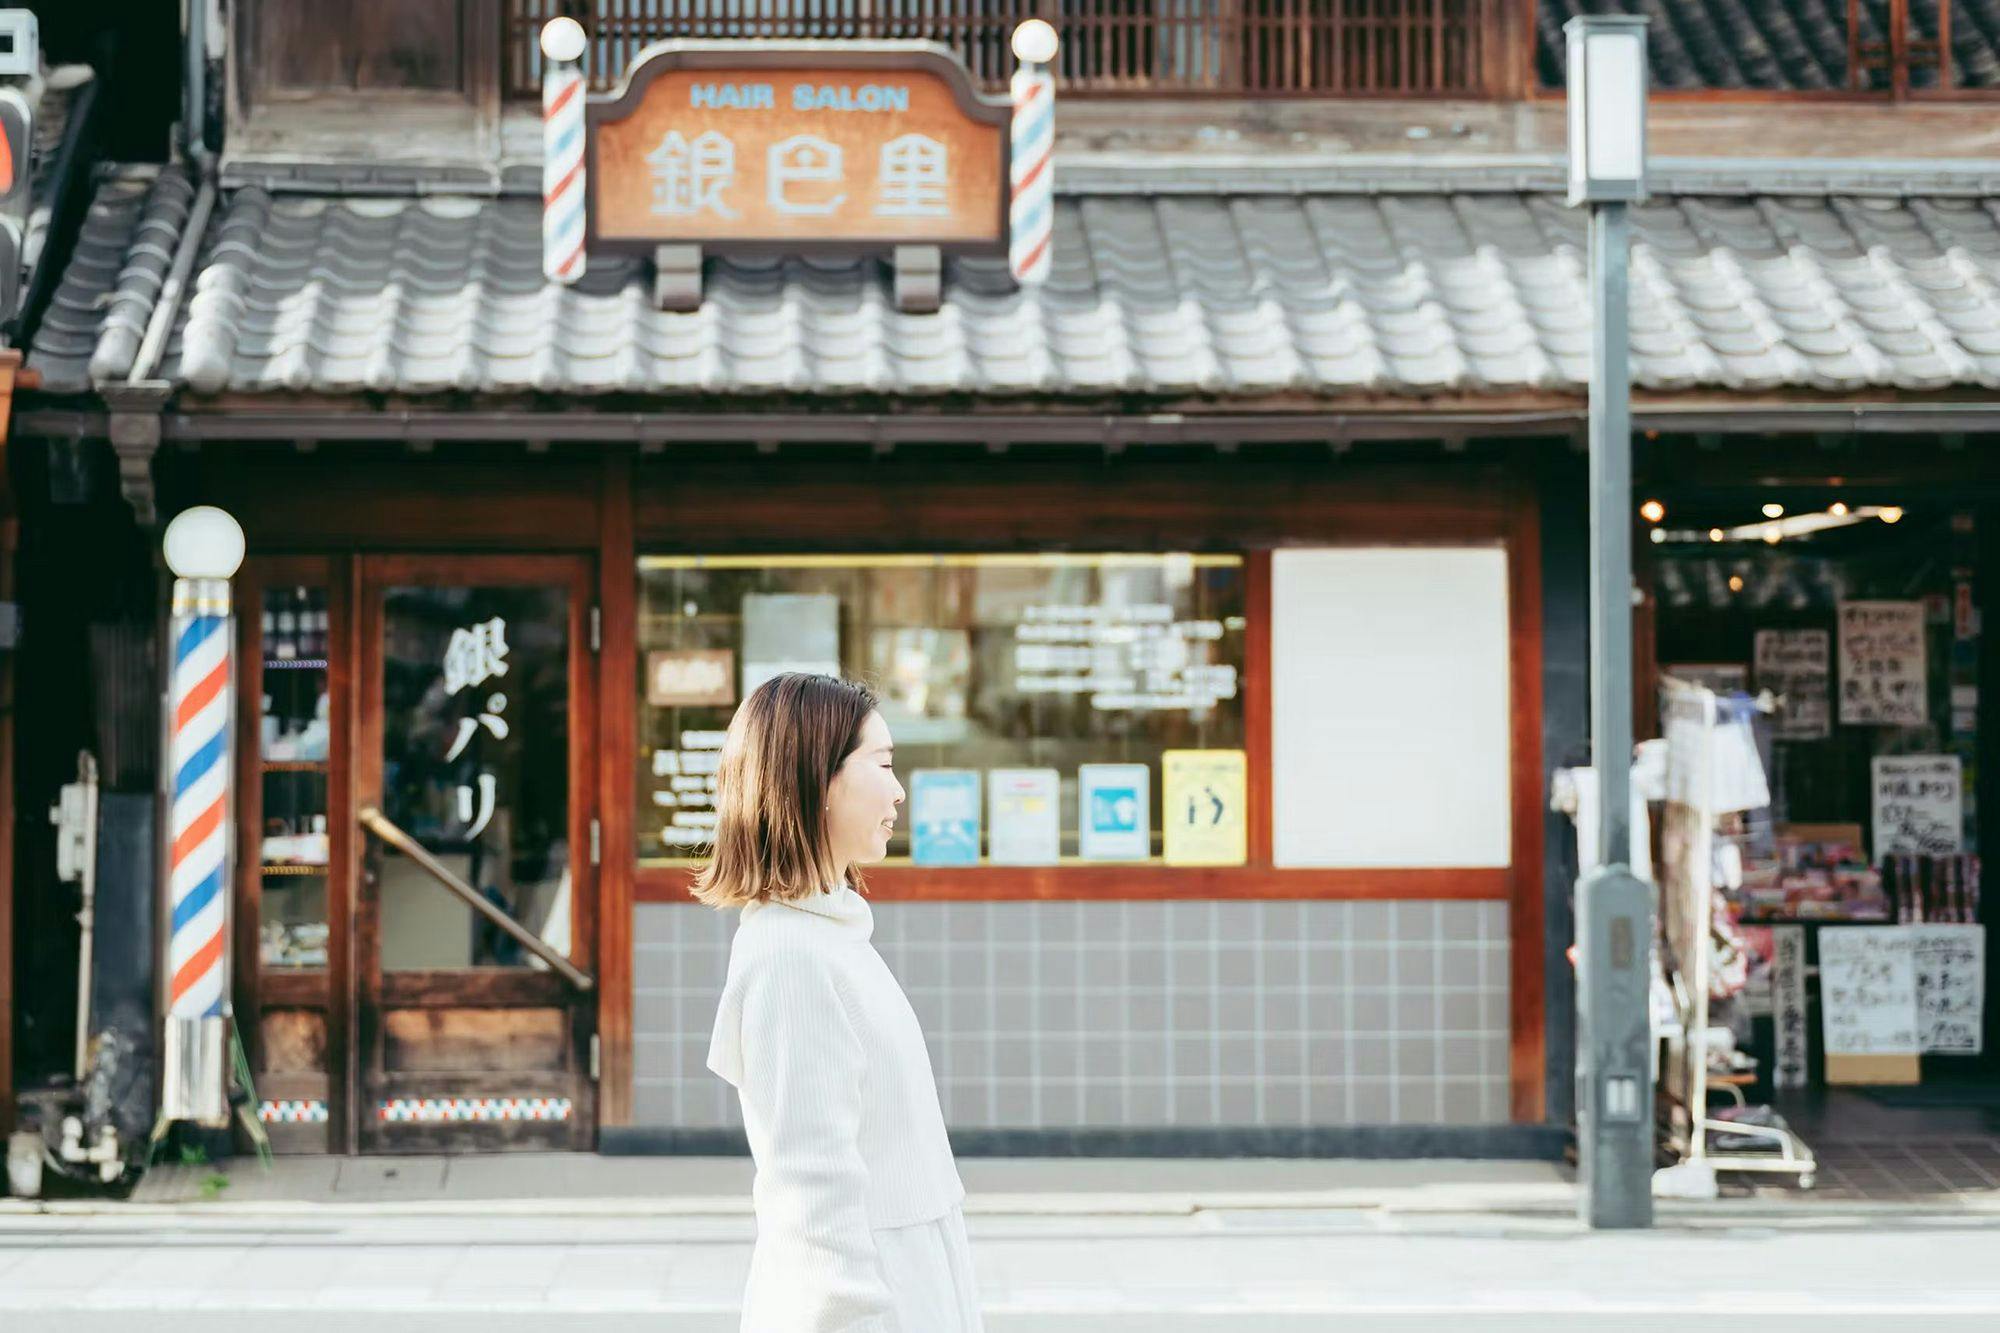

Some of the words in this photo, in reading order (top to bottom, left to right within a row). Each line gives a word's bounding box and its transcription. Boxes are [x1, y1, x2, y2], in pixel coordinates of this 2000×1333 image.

[689, 83, 774, 109] HAIR
[792, 84, 909, 112] SALON
[443, 616, 509, 842] 銀パリ
